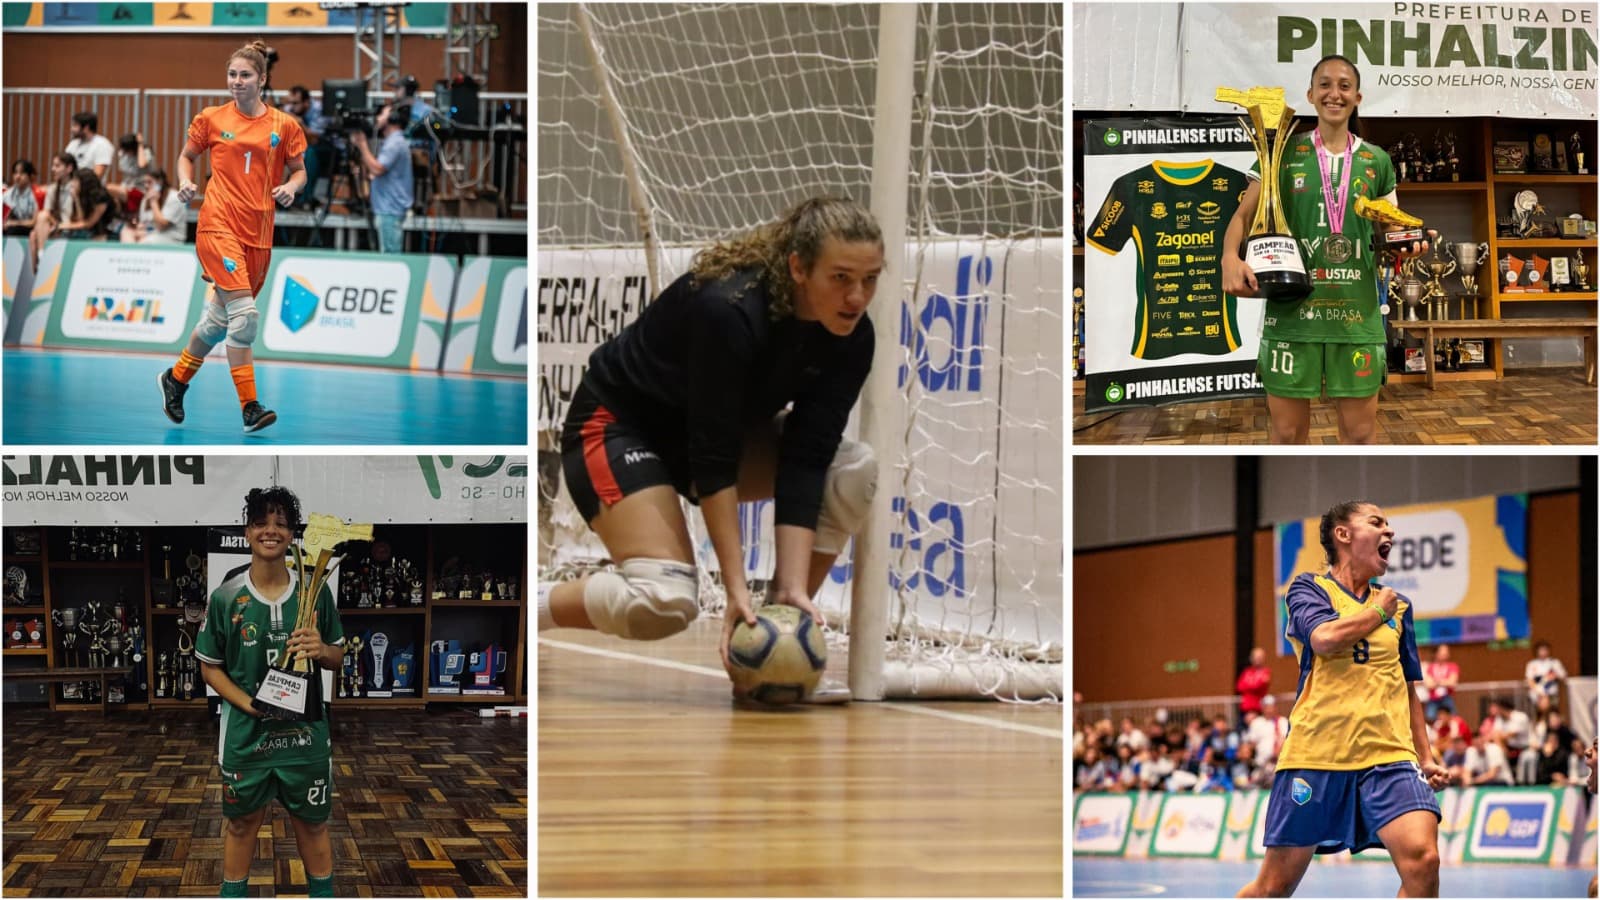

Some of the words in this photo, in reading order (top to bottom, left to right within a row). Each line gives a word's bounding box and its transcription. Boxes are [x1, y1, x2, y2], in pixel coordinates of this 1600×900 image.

[1395, 2, 1548, 22] PREFEITURA
[1562, 9, 1592, 23] DE
[1378, 74, 1433, 87] NOSSO
[1437, 74, 1506, 88] MELHOR,
[1511, 77, 1559, 88] NOSSA
[1122, 128, 1207, 145] PINHALENSE
[1209, 127, 1257, 143] FUTSA
[244, 151, 252, 174] 1
[1102, 201, 1122, 230] SICOOB
[1156, 230, 1214, 249] Zagonel
[1310, 268, 1362, 280] EGUSTAR
[324, 286, 398, 315] CBDE
[1152, 311, 1172, 319] FIVE
[1326, 308, 1362, 320] BRASA
[1270, 349, 1294, 375] 10
[1125, 375, 1214, 399] PINHALENSE
[1216, 372, 1264, 391] FUTSA
[1353, 637, 1370, 664] 8
